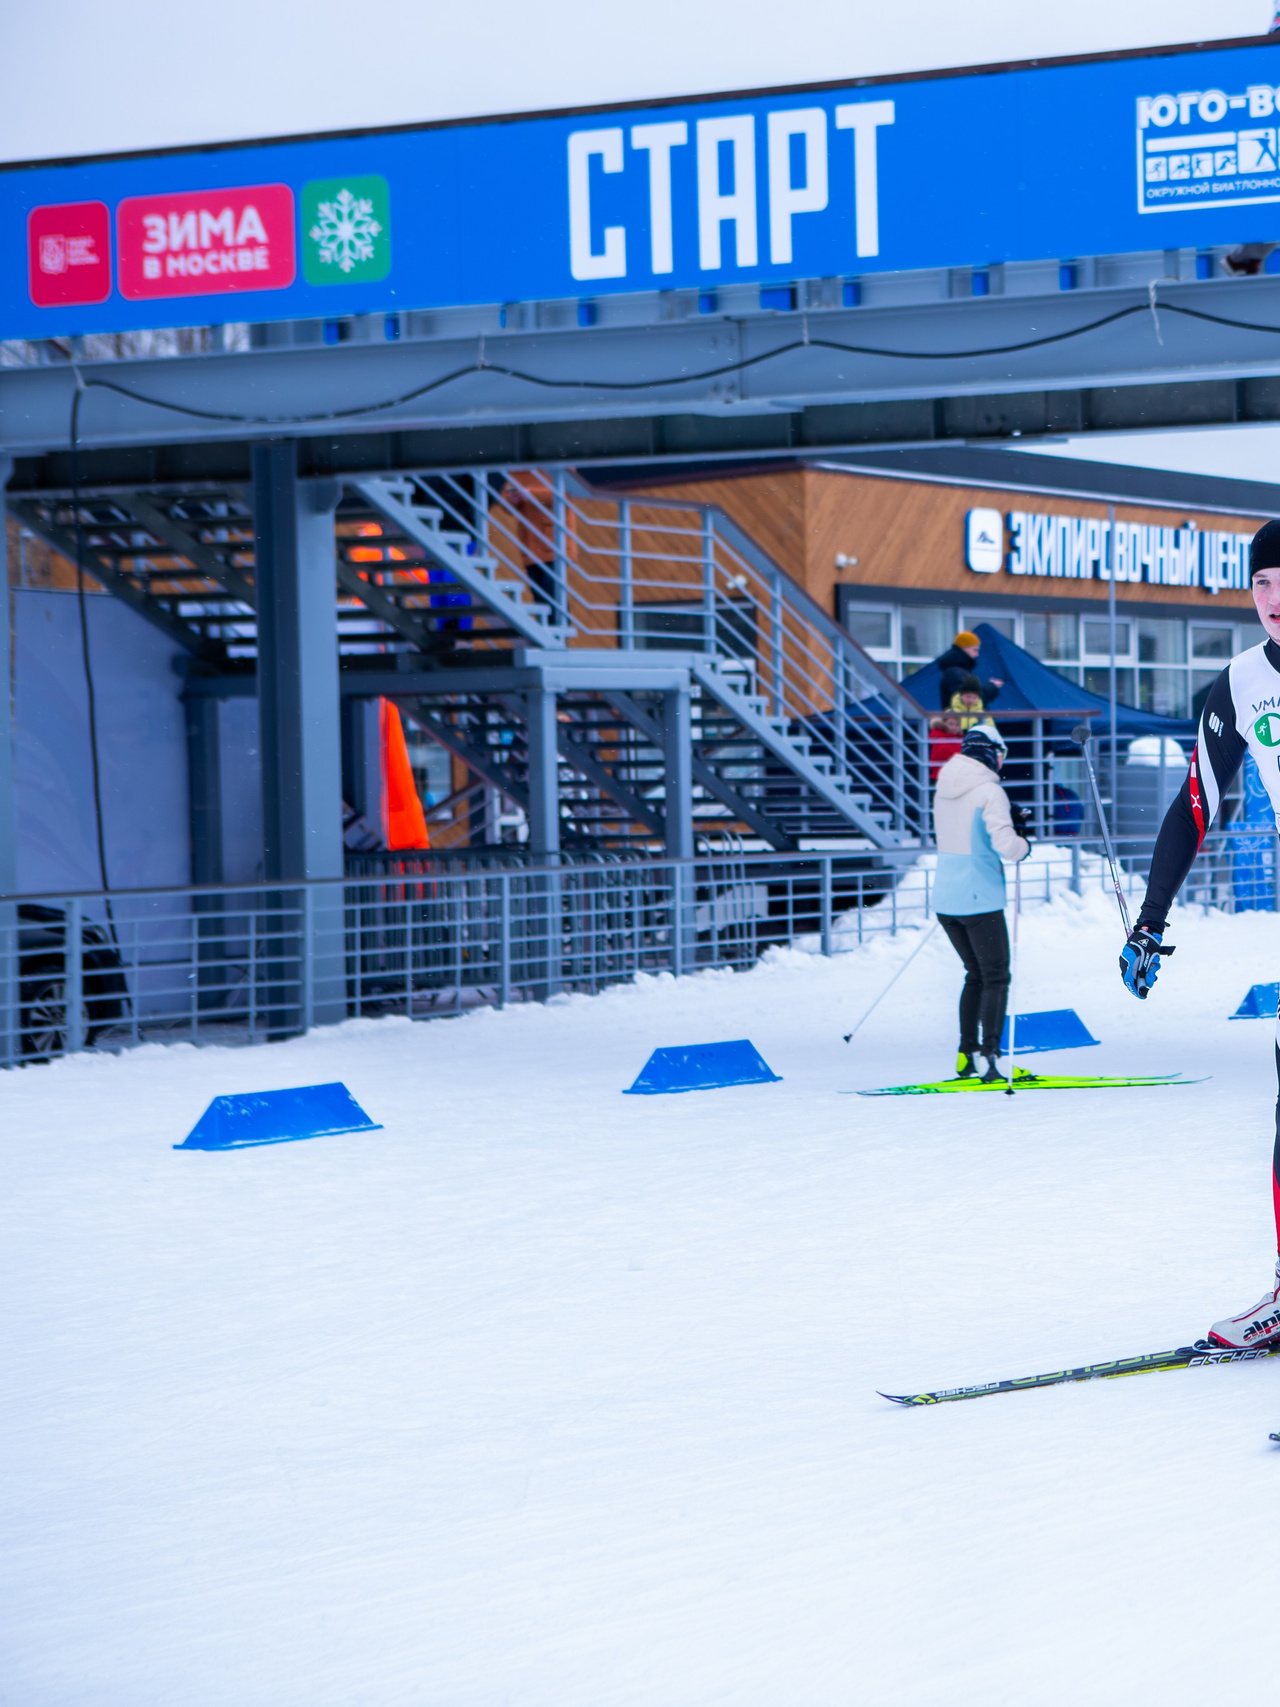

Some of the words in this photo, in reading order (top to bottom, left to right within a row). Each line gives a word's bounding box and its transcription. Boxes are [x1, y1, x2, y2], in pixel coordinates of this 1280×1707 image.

[567, 100, 896, 281] СТАРТ
[1146, 182, 1210, 199] ОКРУЖНОЙ
[142, 205, 270, 254] ЗИМА
[143, 256, 162, 279] В
[166, 247, 270, 278] МОСКВЕ
[1007, 511, 1200, 587] ЭКИПИРОВОЧНЫЙ
[1201, 530, 1254, 594] ЦЕНТ
[1188, 1349, 1270, 1368] FISCHER
